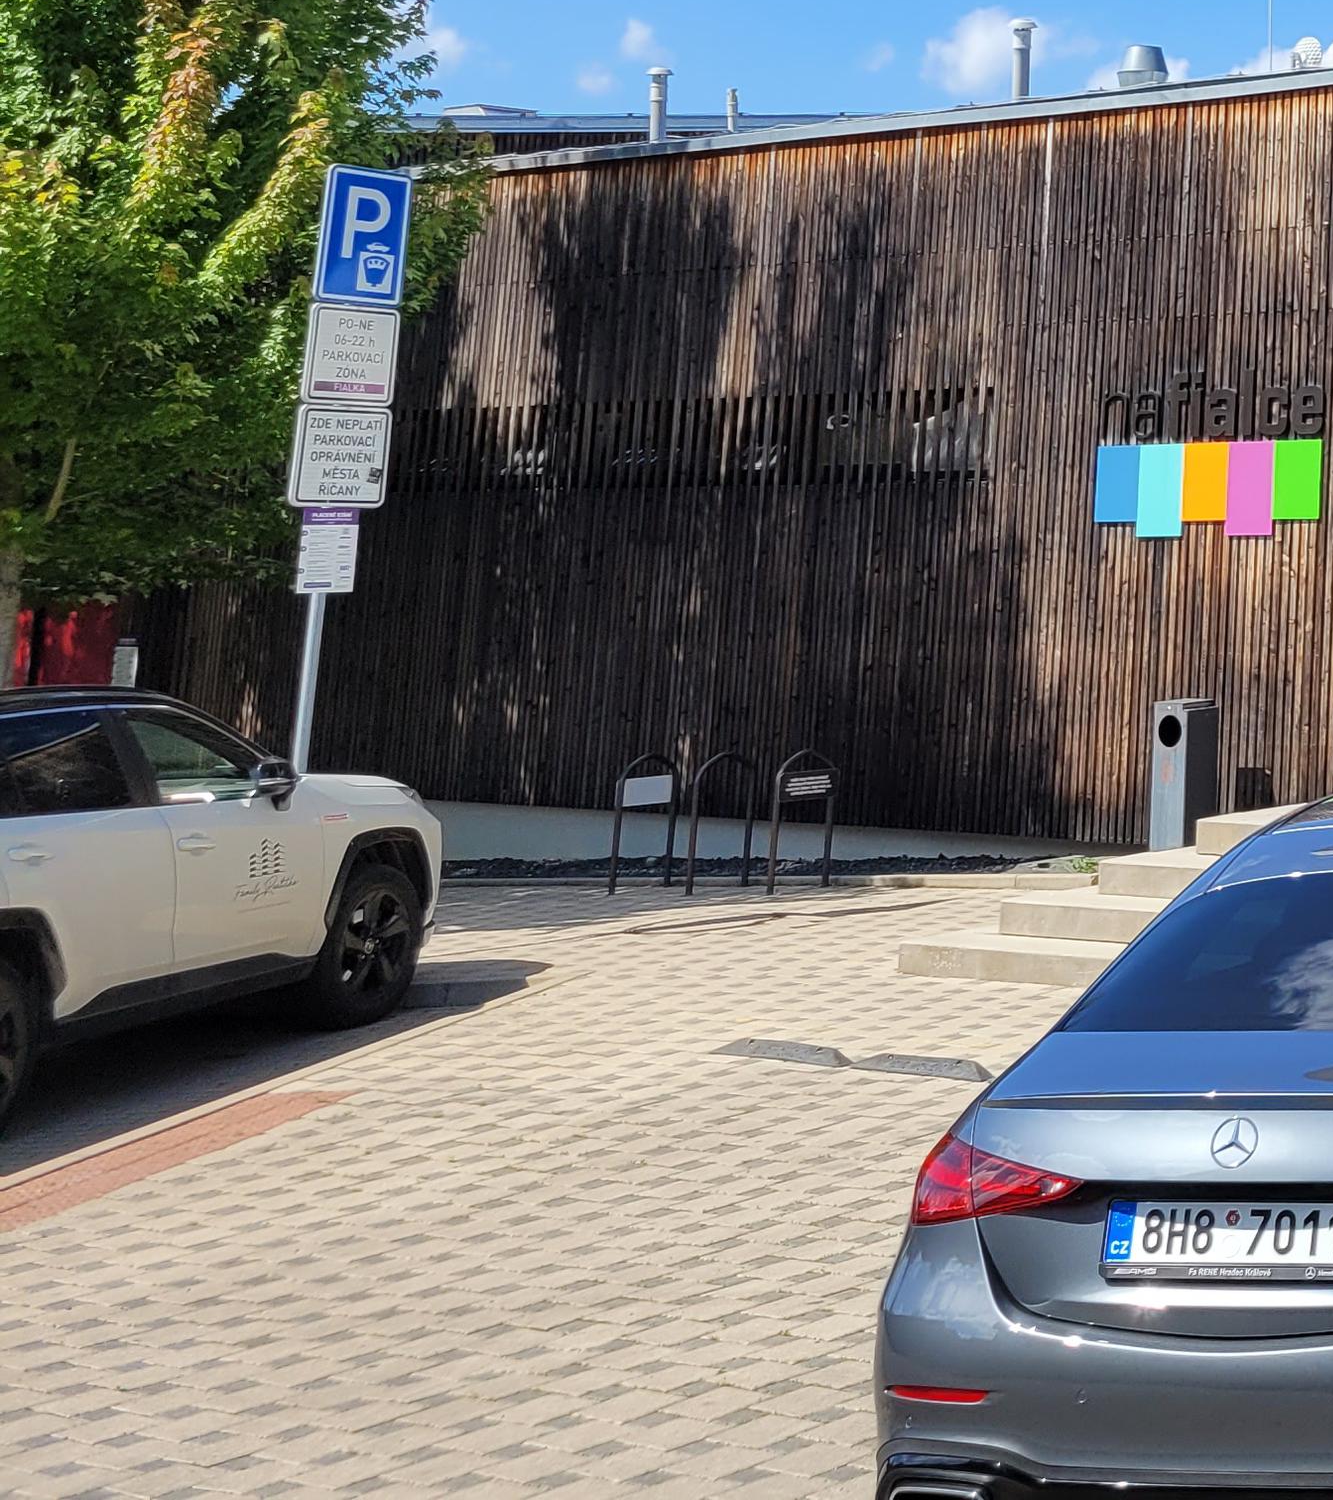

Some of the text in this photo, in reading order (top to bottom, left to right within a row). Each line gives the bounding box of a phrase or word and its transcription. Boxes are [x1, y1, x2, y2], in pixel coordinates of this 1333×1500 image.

[341, 186, 391, 258] P
[338, 317, 375, 331] PO-NE
[334, 333, 376, 348] 06-22 h
[321, 349, 385, 365] PARKOVACÍ
[335, 364, 367, 380] ZÓNA
[333, 383, 366, 392] FIALKA
[310, 417, 385, 431] ZDE NEPLATÍ
[313, 434, 377, 447] PARKOVACÍ
[310, 449, 377, 463] OPRÁVNĚNÍ
[321, 466, 360, 480] MĚSTA
[318, 482, 361, 496] ŘÍČANY
[1142, 1208, 1216, 1255] 8H8
[1110, 1240, 1129, 1255] CZ
[1127, 1267, 1158, 1275] AMG
[1219, 1267, 1244, 1277] Hradec
